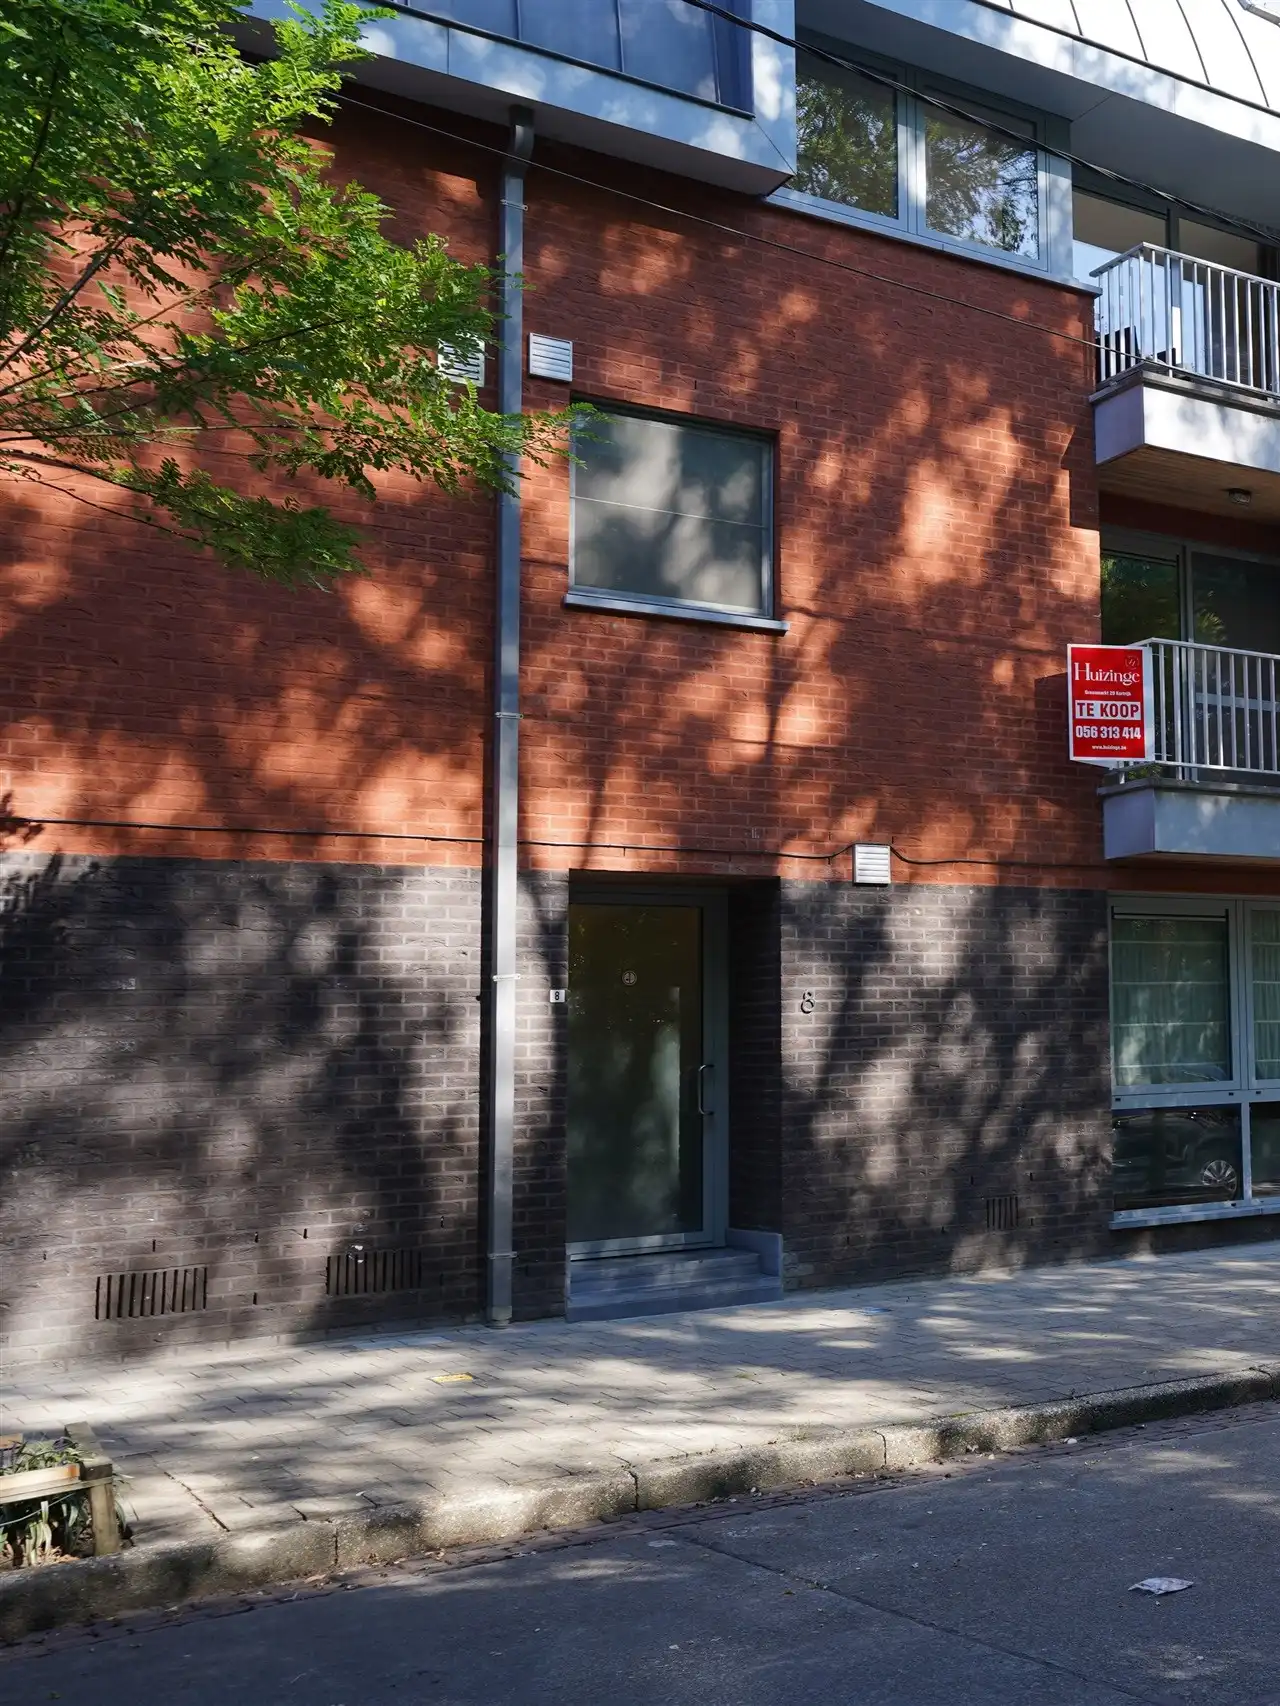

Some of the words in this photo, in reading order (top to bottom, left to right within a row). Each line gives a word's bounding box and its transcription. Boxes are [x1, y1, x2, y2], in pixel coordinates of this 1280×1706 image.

[1074, 662, 1140, 686] Huizinge
[1077, 703, 1095, 717] TE
[1100, 703, 1139, 718] KOOP
[1075, 725, 1098, 739] 056
[1100, 726, 1120, 739] 313
[1122, 726, 1141, 740] 414
[554, 991, 560, 1001] 8
[801, 990, 815, 1015] 8
